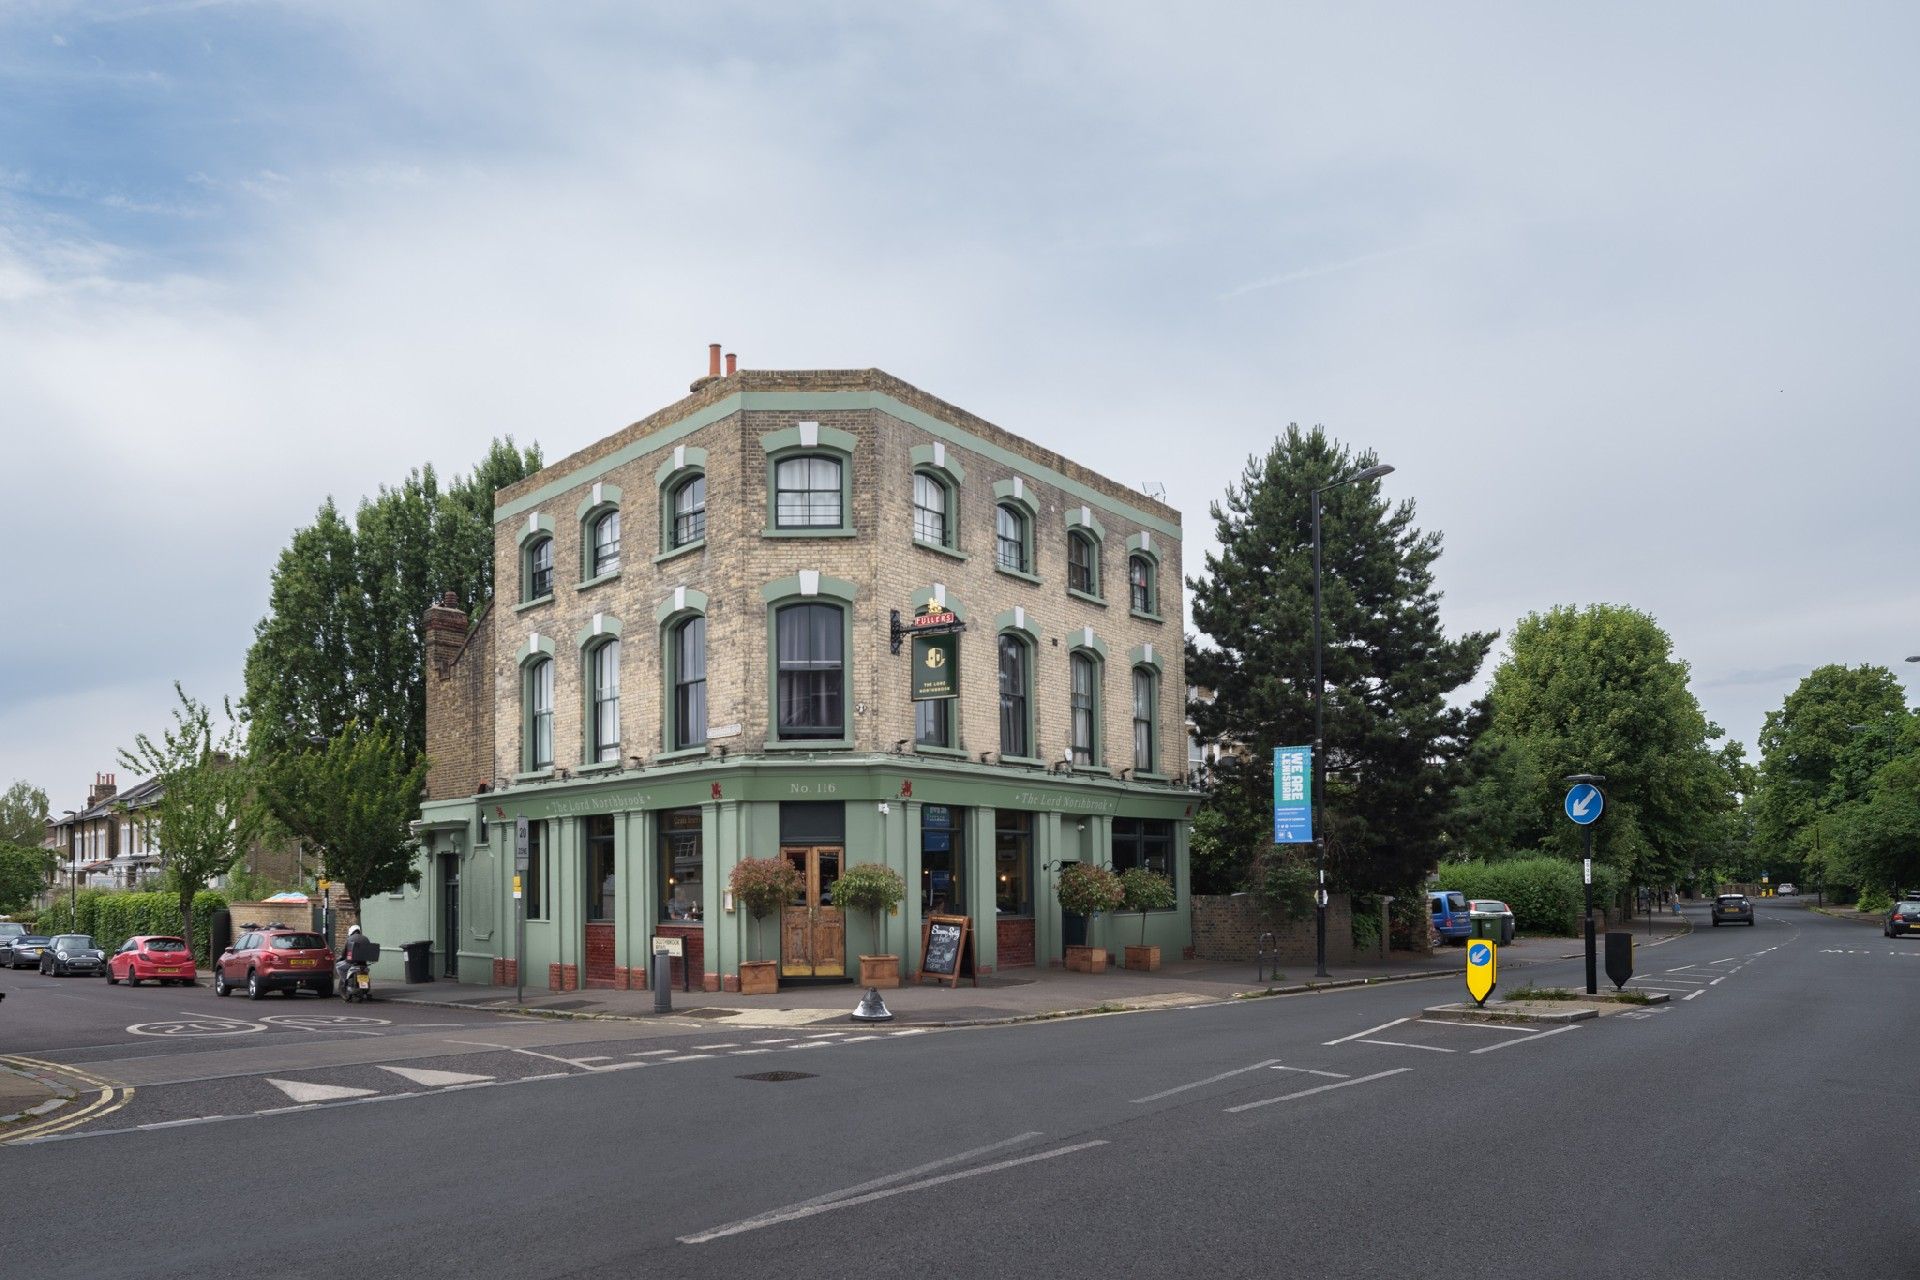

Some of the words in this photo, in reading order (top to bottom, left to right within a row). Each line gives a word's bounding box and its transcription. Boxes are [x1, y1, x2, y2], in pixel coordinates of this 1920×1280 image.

[1292, 753, 1303, 773] WE
[1282, 753, 1291, 800] LEWISHAM
[1292, 776, 1303, 800] ARE
[551, 801, 568, 814] The
[569, 798, 590, 811] Lord
[592, 792, 645, 809] Northbrook
[1022, 792, 1037, 805] The
[1040, 794, 1061, 807] Lord
[1063, 796, 1107, 810] Northbrook
[519, 827, 527, 838] 20
